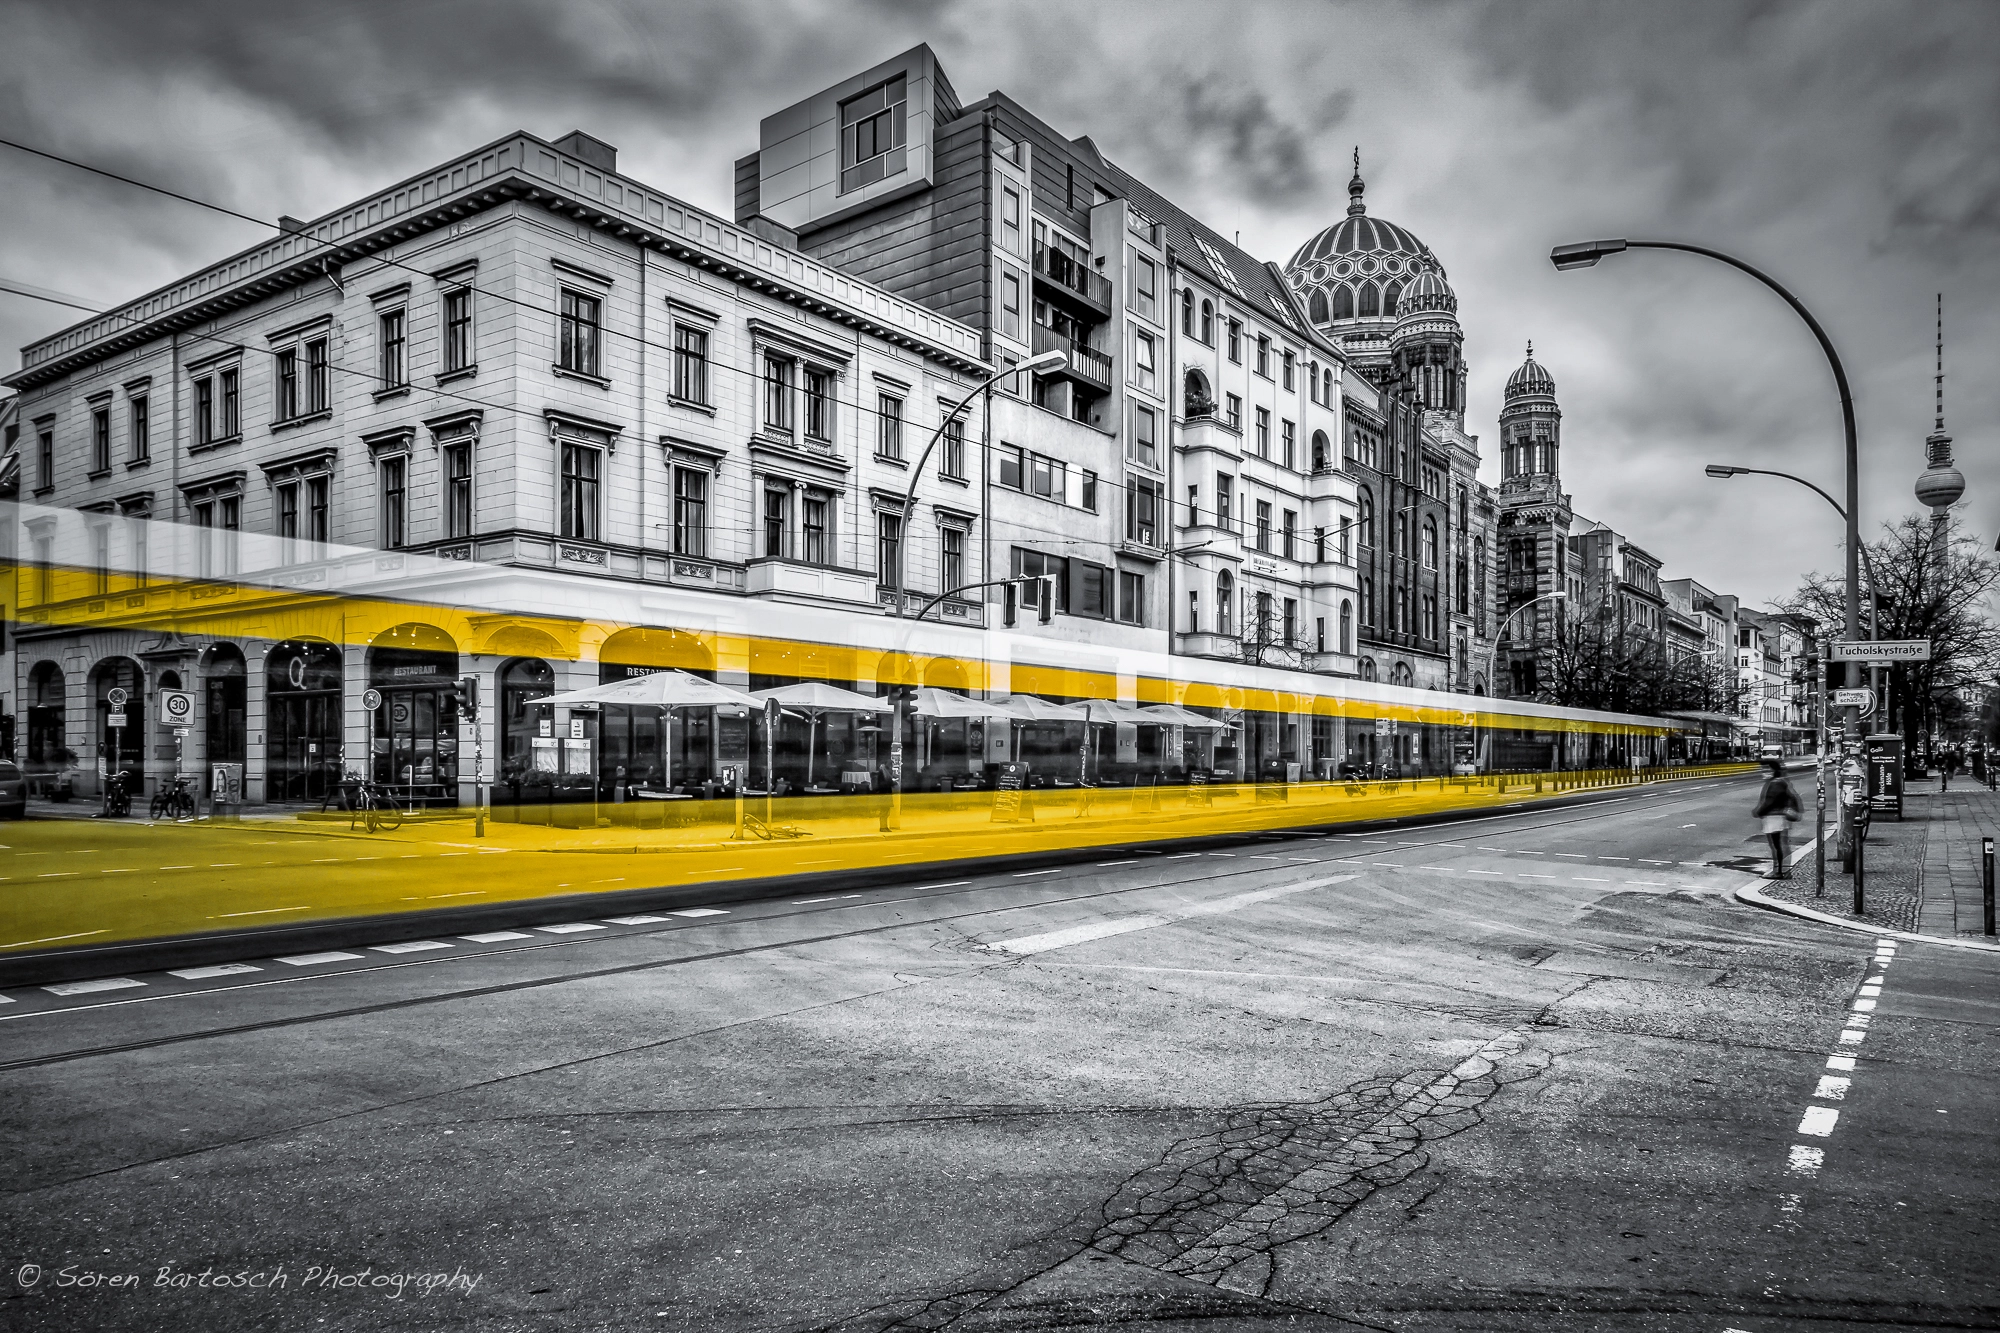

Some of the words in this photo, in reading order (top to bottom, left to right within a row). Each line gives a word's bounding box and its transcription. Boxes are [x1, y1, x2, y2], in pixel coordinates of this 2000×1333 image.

[1837, 645, 1923, 656] Tucholskystraße
[394, 665, 437, 676] RESTAURANT
[627, 667, 662, 676] RESTA
[171, 700, 186, 710] 30
